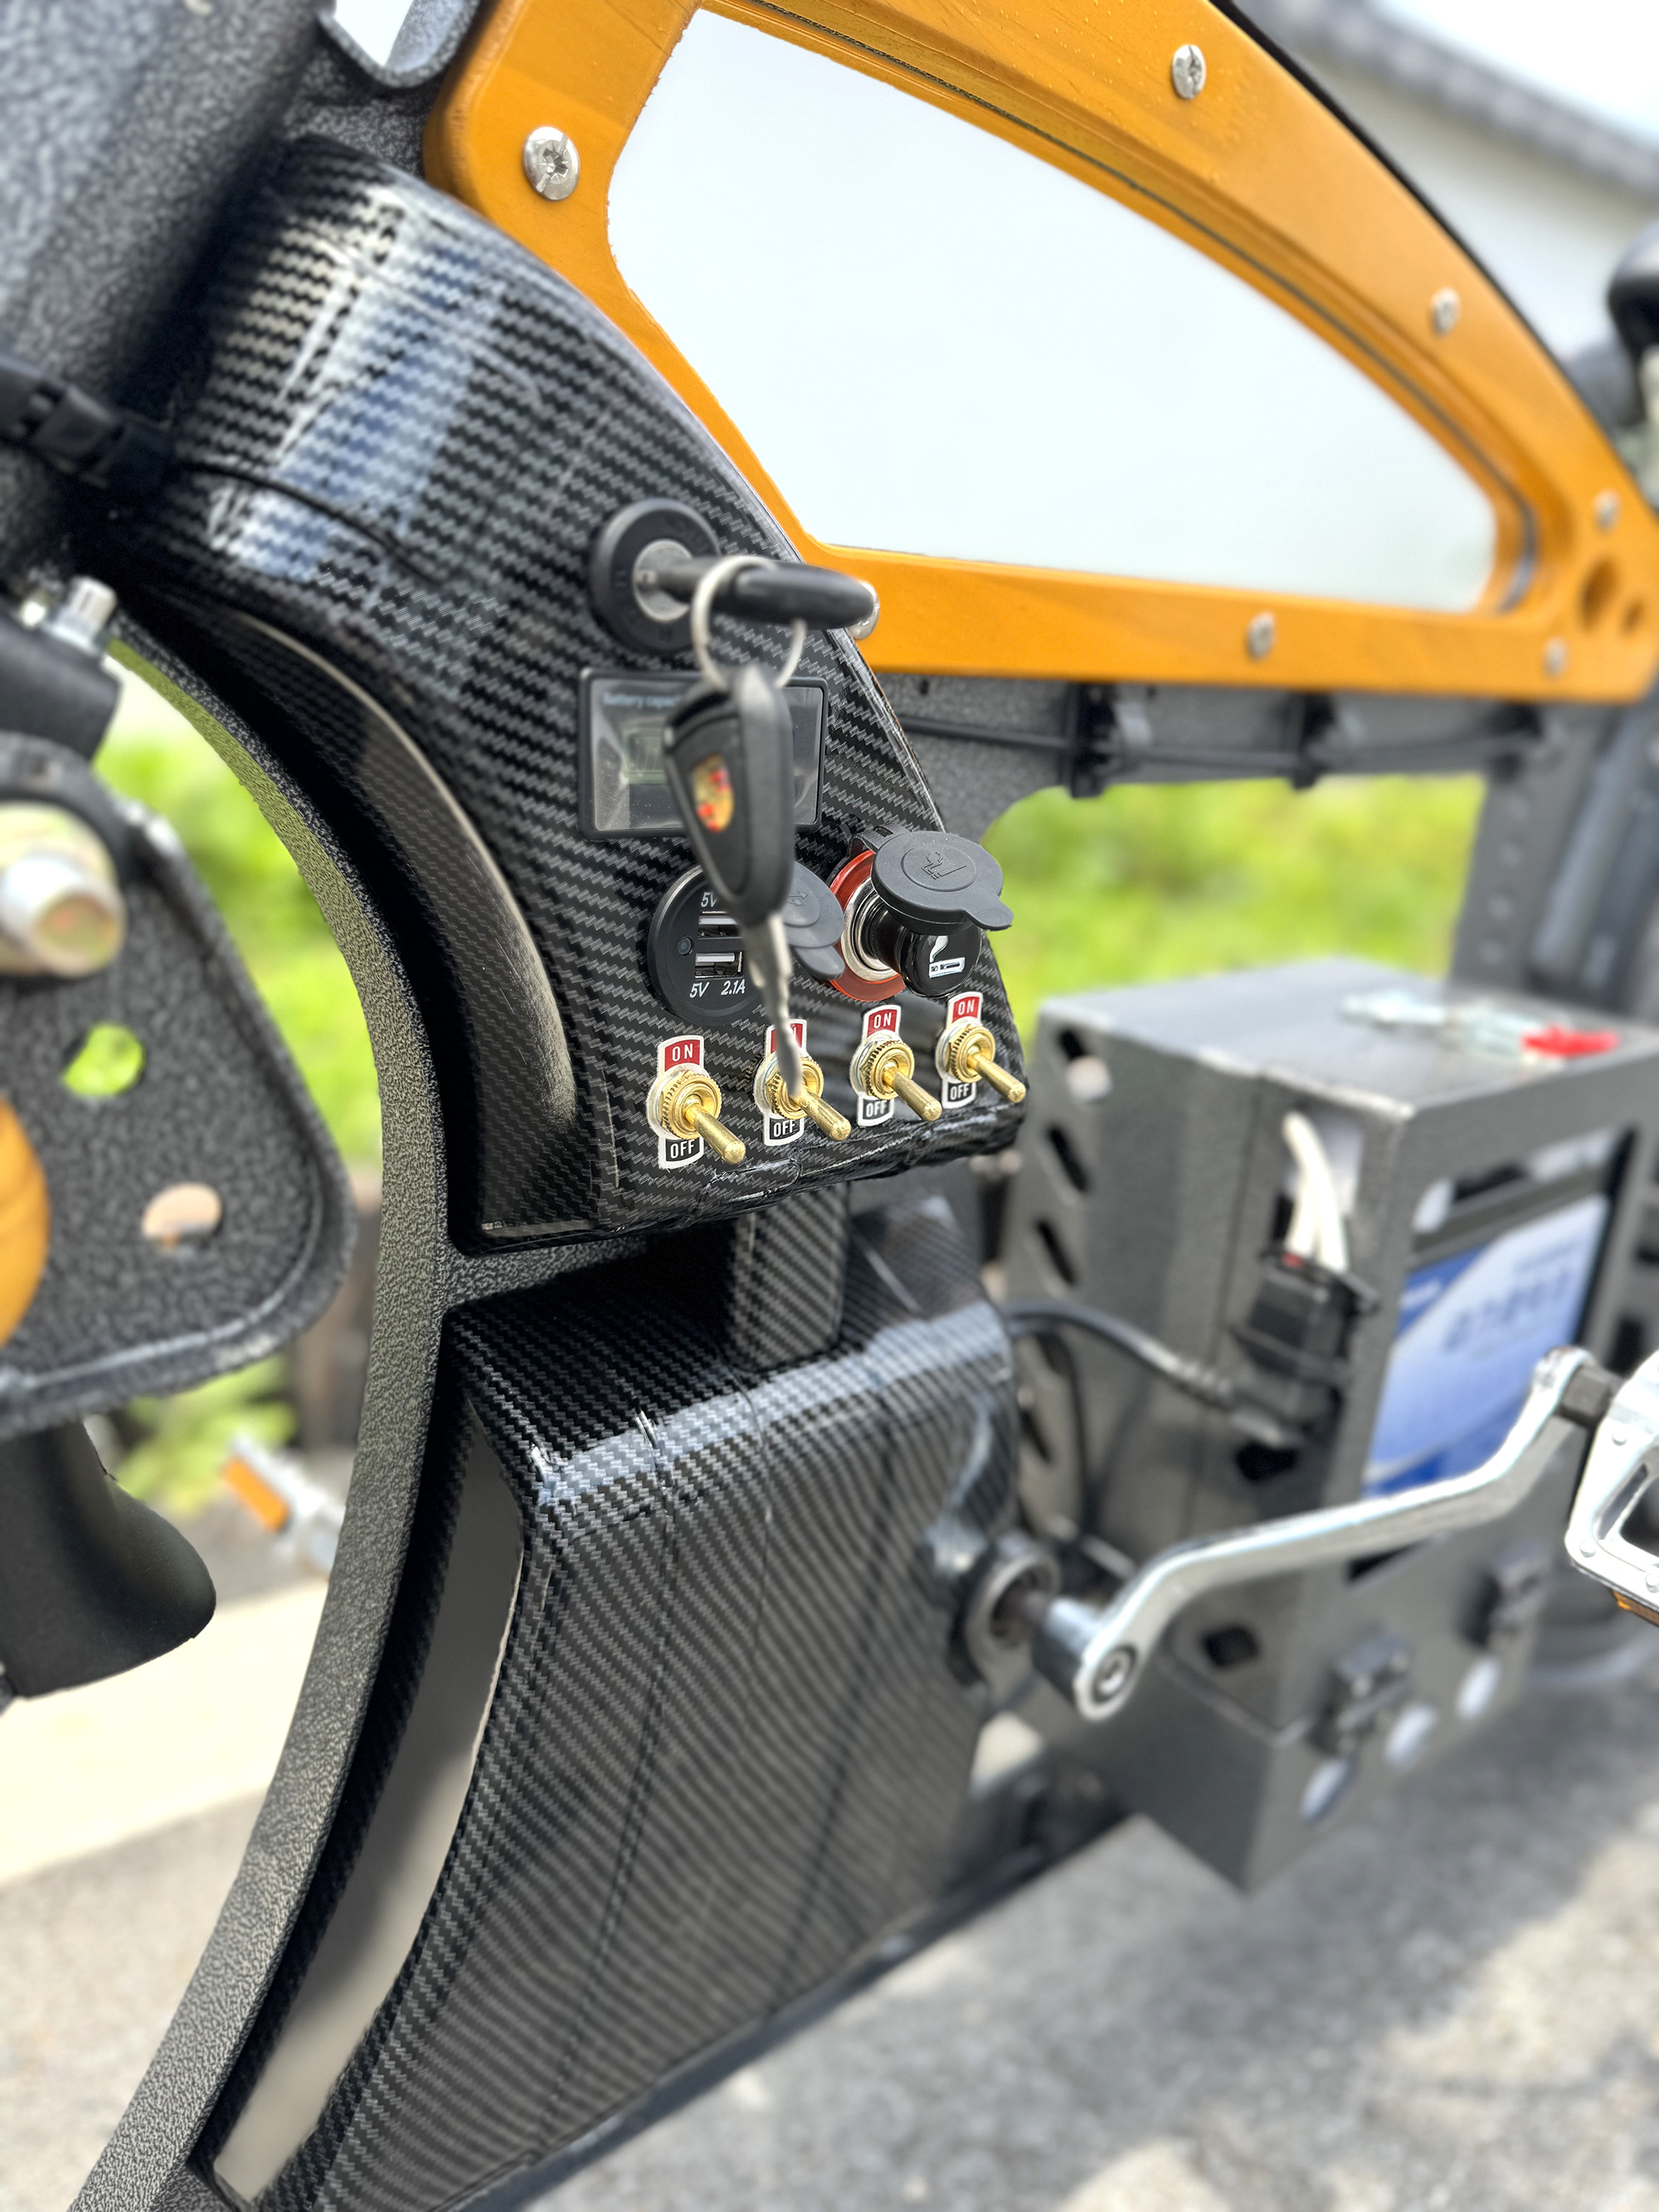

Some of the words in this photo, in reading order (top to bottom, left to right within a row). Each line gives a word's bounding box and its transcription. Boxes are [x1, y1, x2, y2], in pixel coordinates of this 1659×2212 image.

[689, 981, 710, 999] 5V
[721, 979, 746, 995] 2.1A
[957, 999, 975, 1015] ON
[873, 1012, 892, 1028] ON
[672, 1043, 693, 1062] ON
[950, 1082, 969, 1101] OFF
[866, 1100, 888, 1117] OFF
[773, 1119, 795, 1137] OFF
[670, 1139, 695, 1159] OFF
